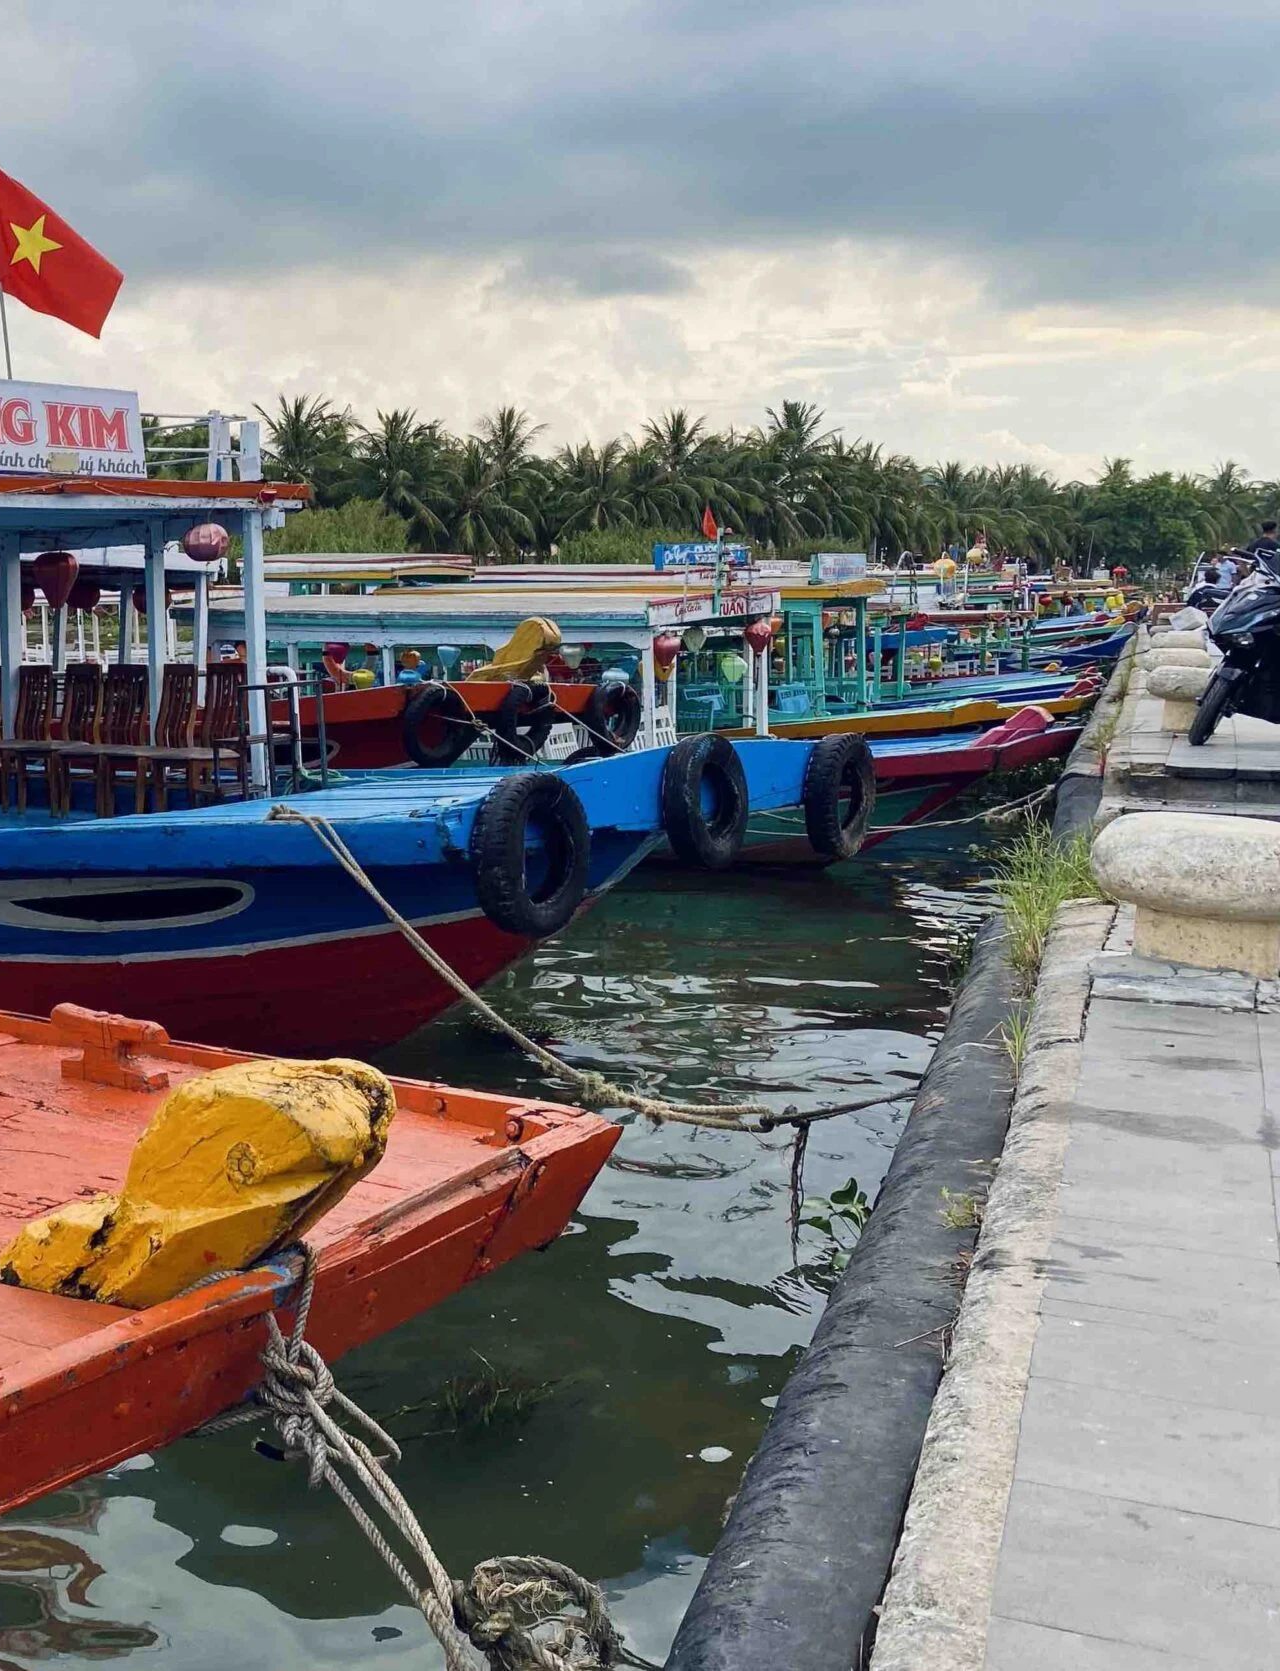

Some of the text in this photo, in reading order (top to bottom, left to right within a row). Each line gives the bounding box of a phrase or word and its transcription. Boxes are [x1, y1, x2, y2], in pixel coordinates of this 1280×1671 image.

[43, 400, 133, 452] KIM
[28, 452, 49, 469] ch
[78, 455, 94, 476] uý
[98, 458, 145, 474] khách!
